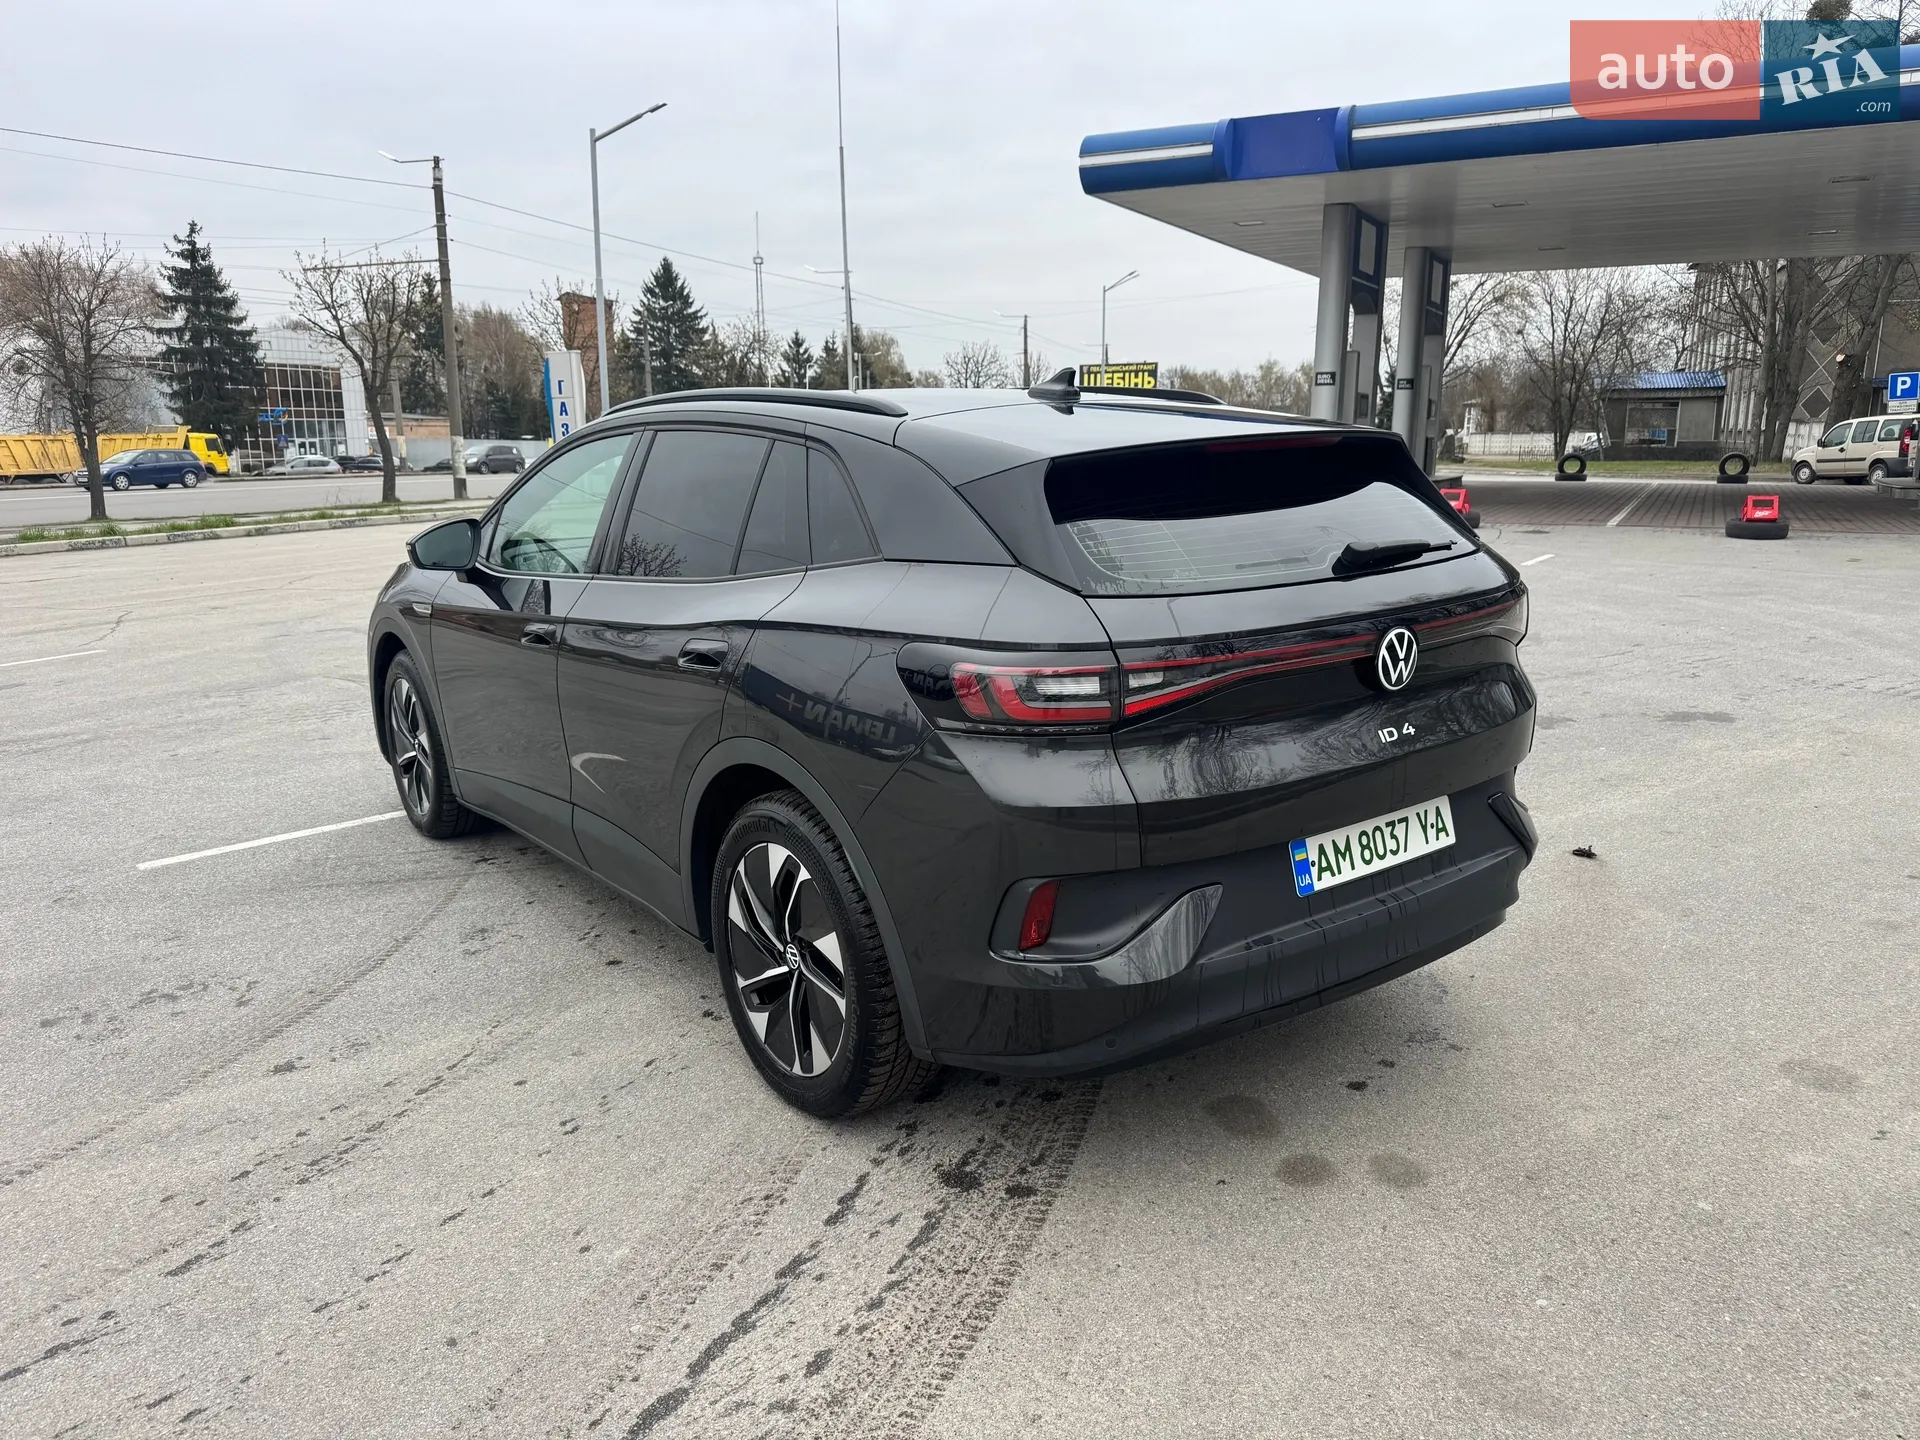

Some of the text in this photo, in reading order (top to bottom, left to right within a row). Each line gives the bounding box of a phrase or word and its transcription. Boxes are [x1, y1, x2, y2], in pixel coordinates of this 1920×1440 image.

[1896, 376, 1911, 396] P
[1378, 722, 1416, 744] ID 4
[1317, 805, 1450, 882] AM 8037 YA
[1298, 874, 1312, 887] UA
